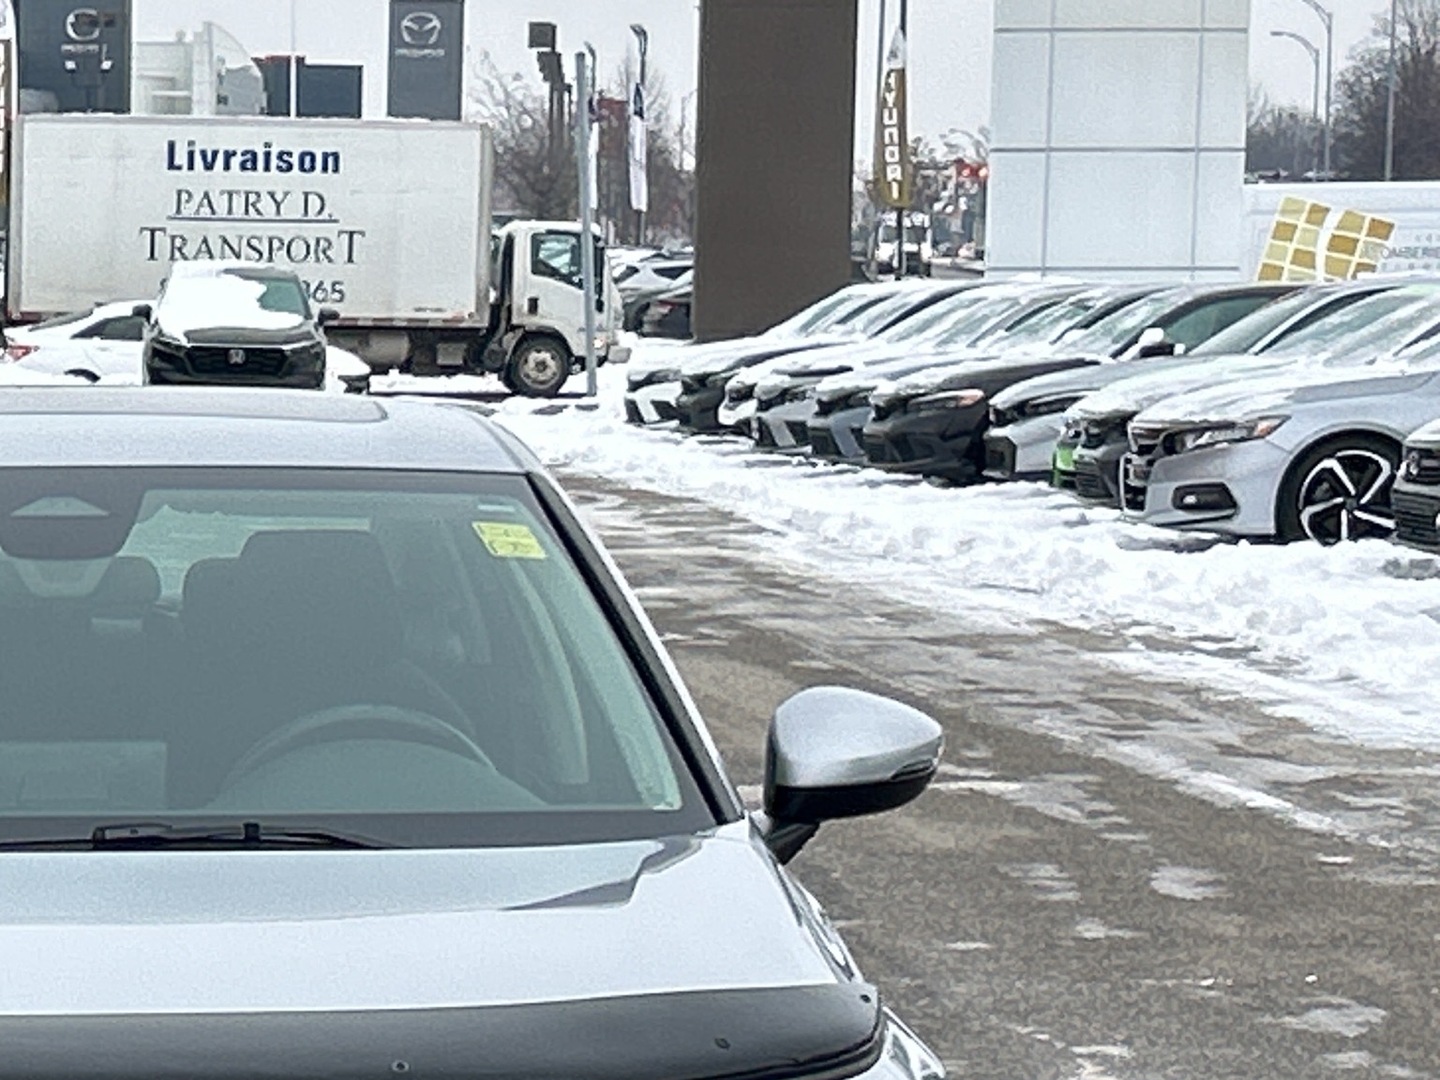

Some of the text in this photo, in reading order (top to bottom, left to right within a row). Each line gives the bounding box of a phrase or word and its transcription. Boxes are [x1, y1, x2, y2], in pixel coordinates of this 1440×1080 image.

[166, 140, 341, 174] Livraison
[174, 188, 334, 219] PATRY D.
[139, 227, 366, 264] TRANSPORT
